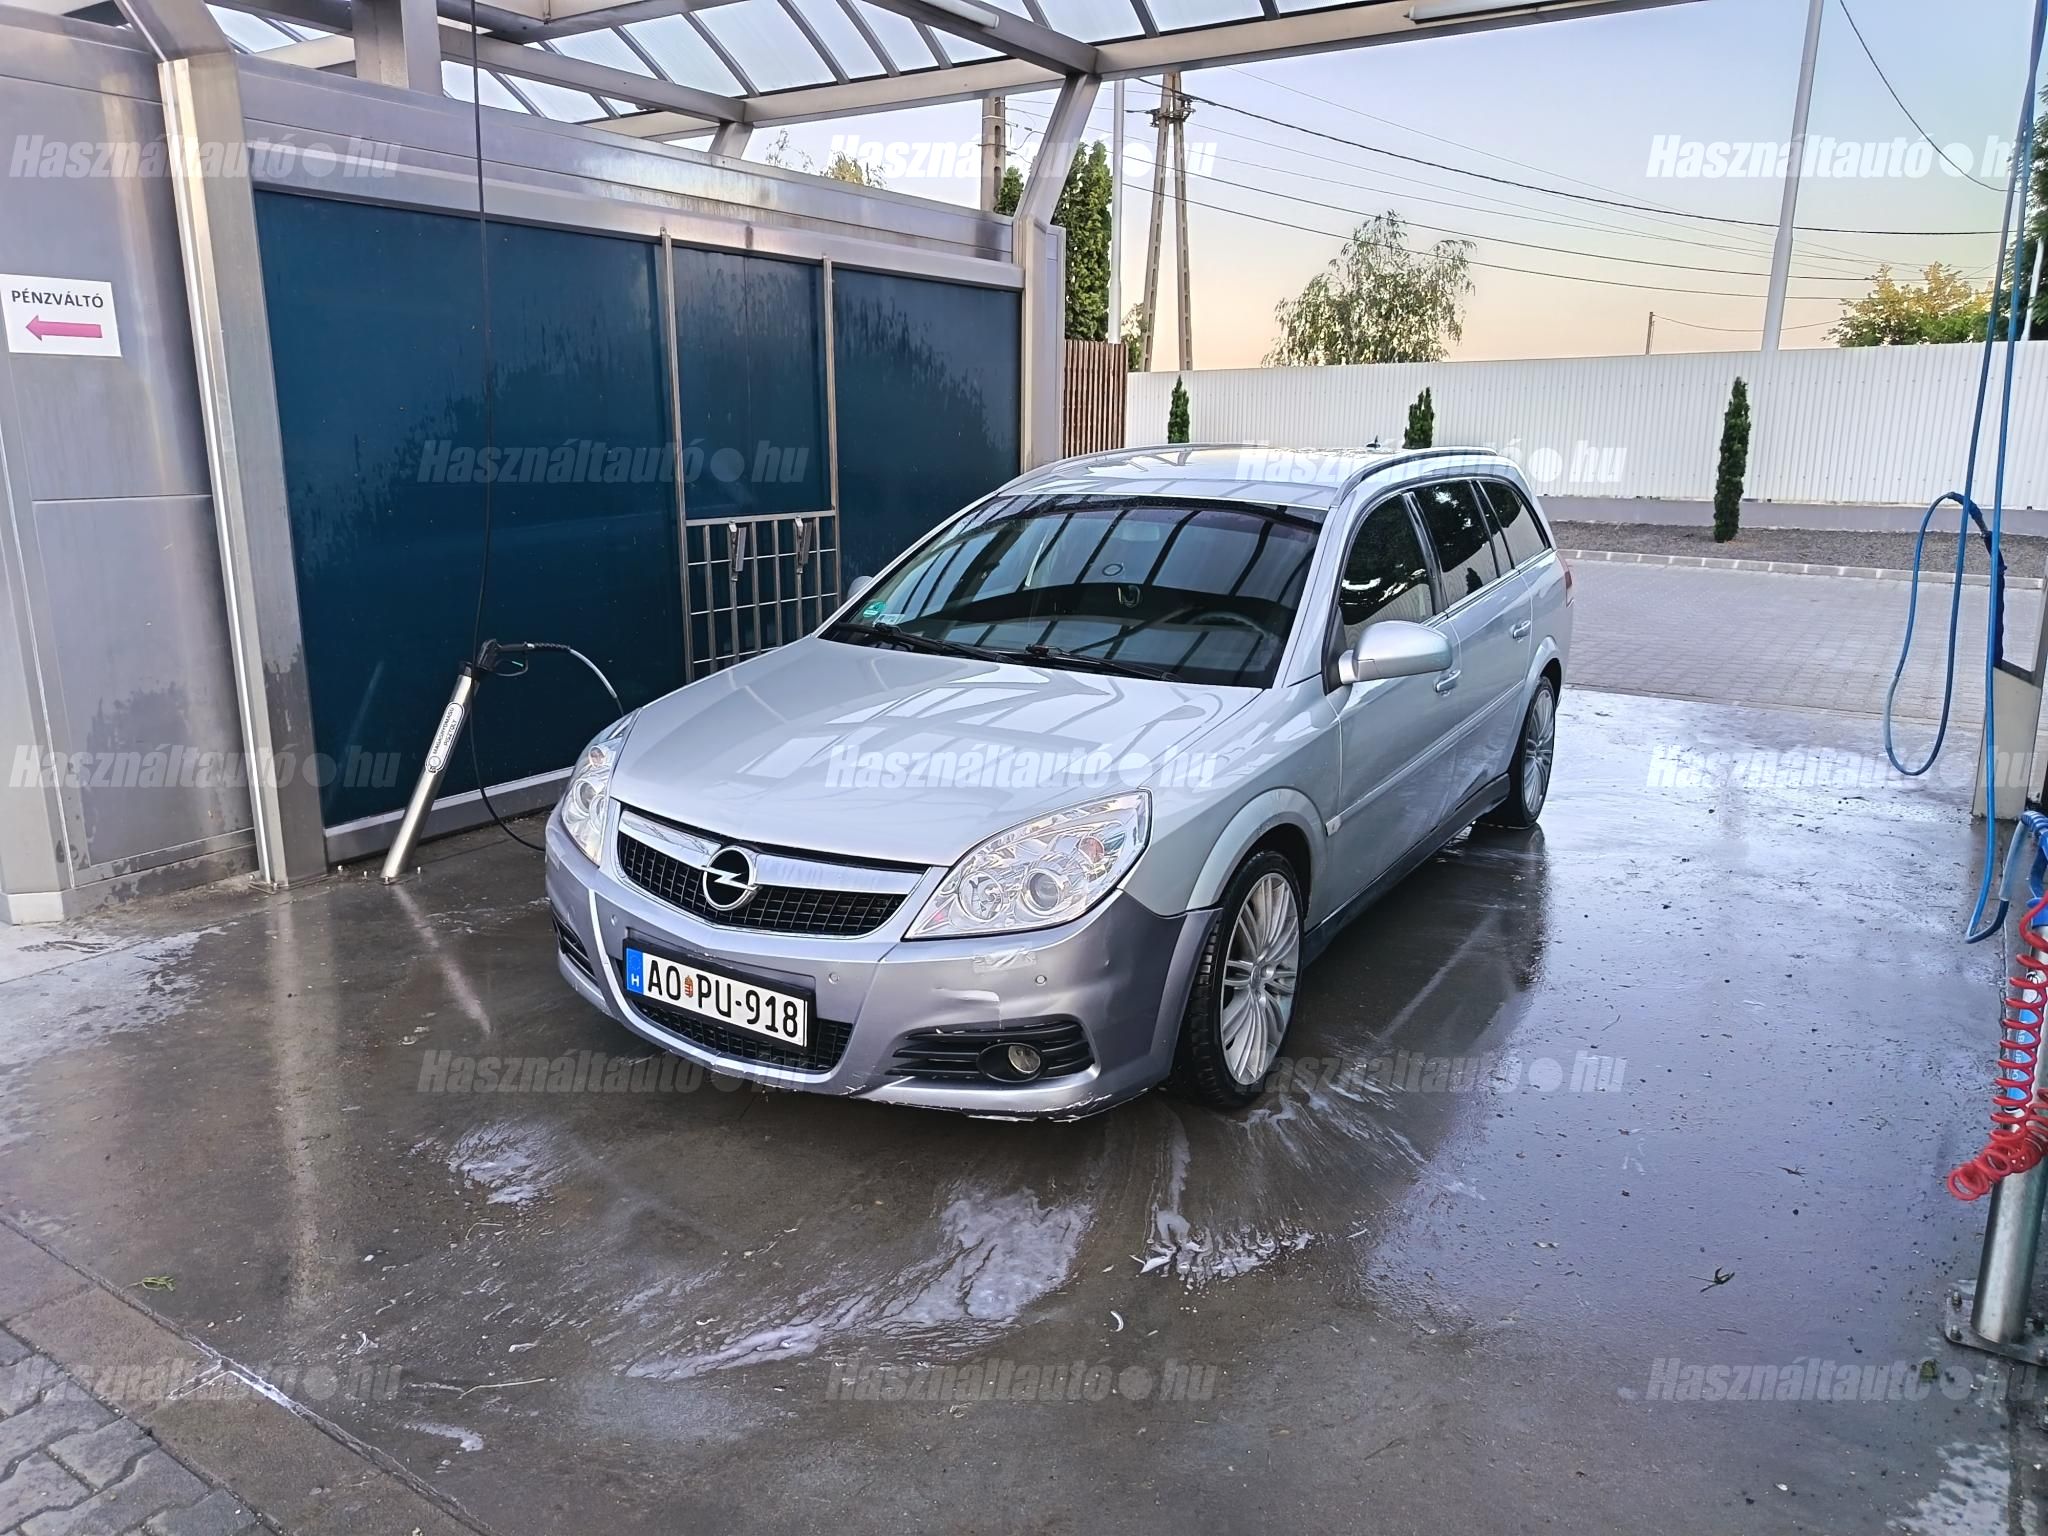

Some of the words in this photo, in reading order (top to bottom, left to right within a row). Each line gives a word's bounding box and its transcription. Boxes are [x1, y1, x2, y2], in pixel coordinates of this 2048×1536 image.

[11, 287, 104, 309] PÉNZVÁLTÓ
[630, 973, 641, 988] H
[648, 959, 682, 1001] AO
[696, 973, 798, 1038] PU-918
